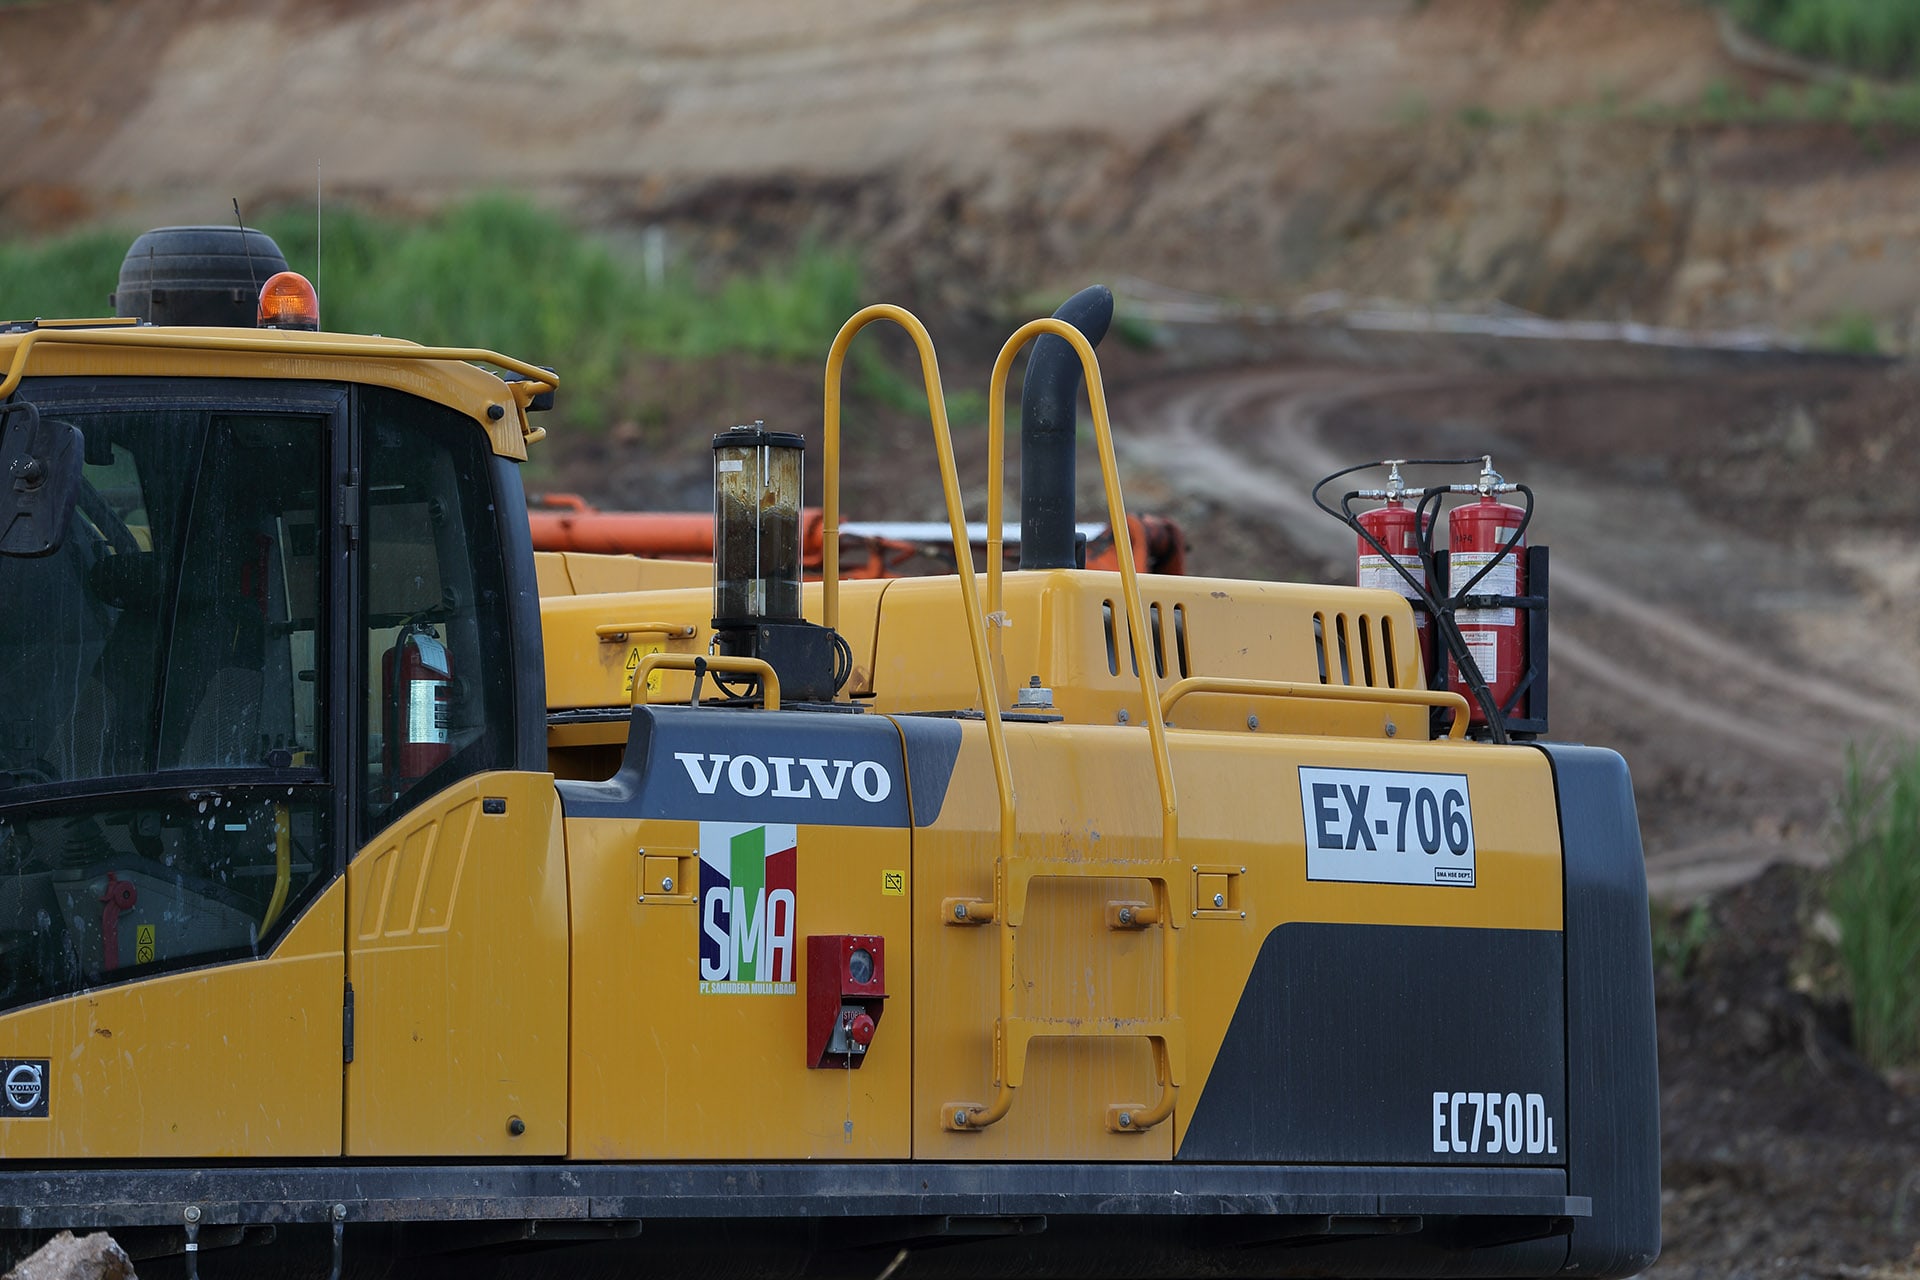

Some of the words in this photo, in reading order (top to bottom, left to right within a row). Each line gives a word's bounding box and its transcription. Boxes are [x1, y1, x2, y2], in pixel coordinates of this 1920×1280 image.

[674, 752, 891, 803] VOLVO
[1312, 782, 1469, 856] EX-706
[700, 886, 796, 982] SMA
[711, 982, 750, 994] SAMUDERA
[751, 983, 773, 995] MULIA
[774, 983, 796, 995] ABADI
[8, 1084, 40, 1092] VOLVO
